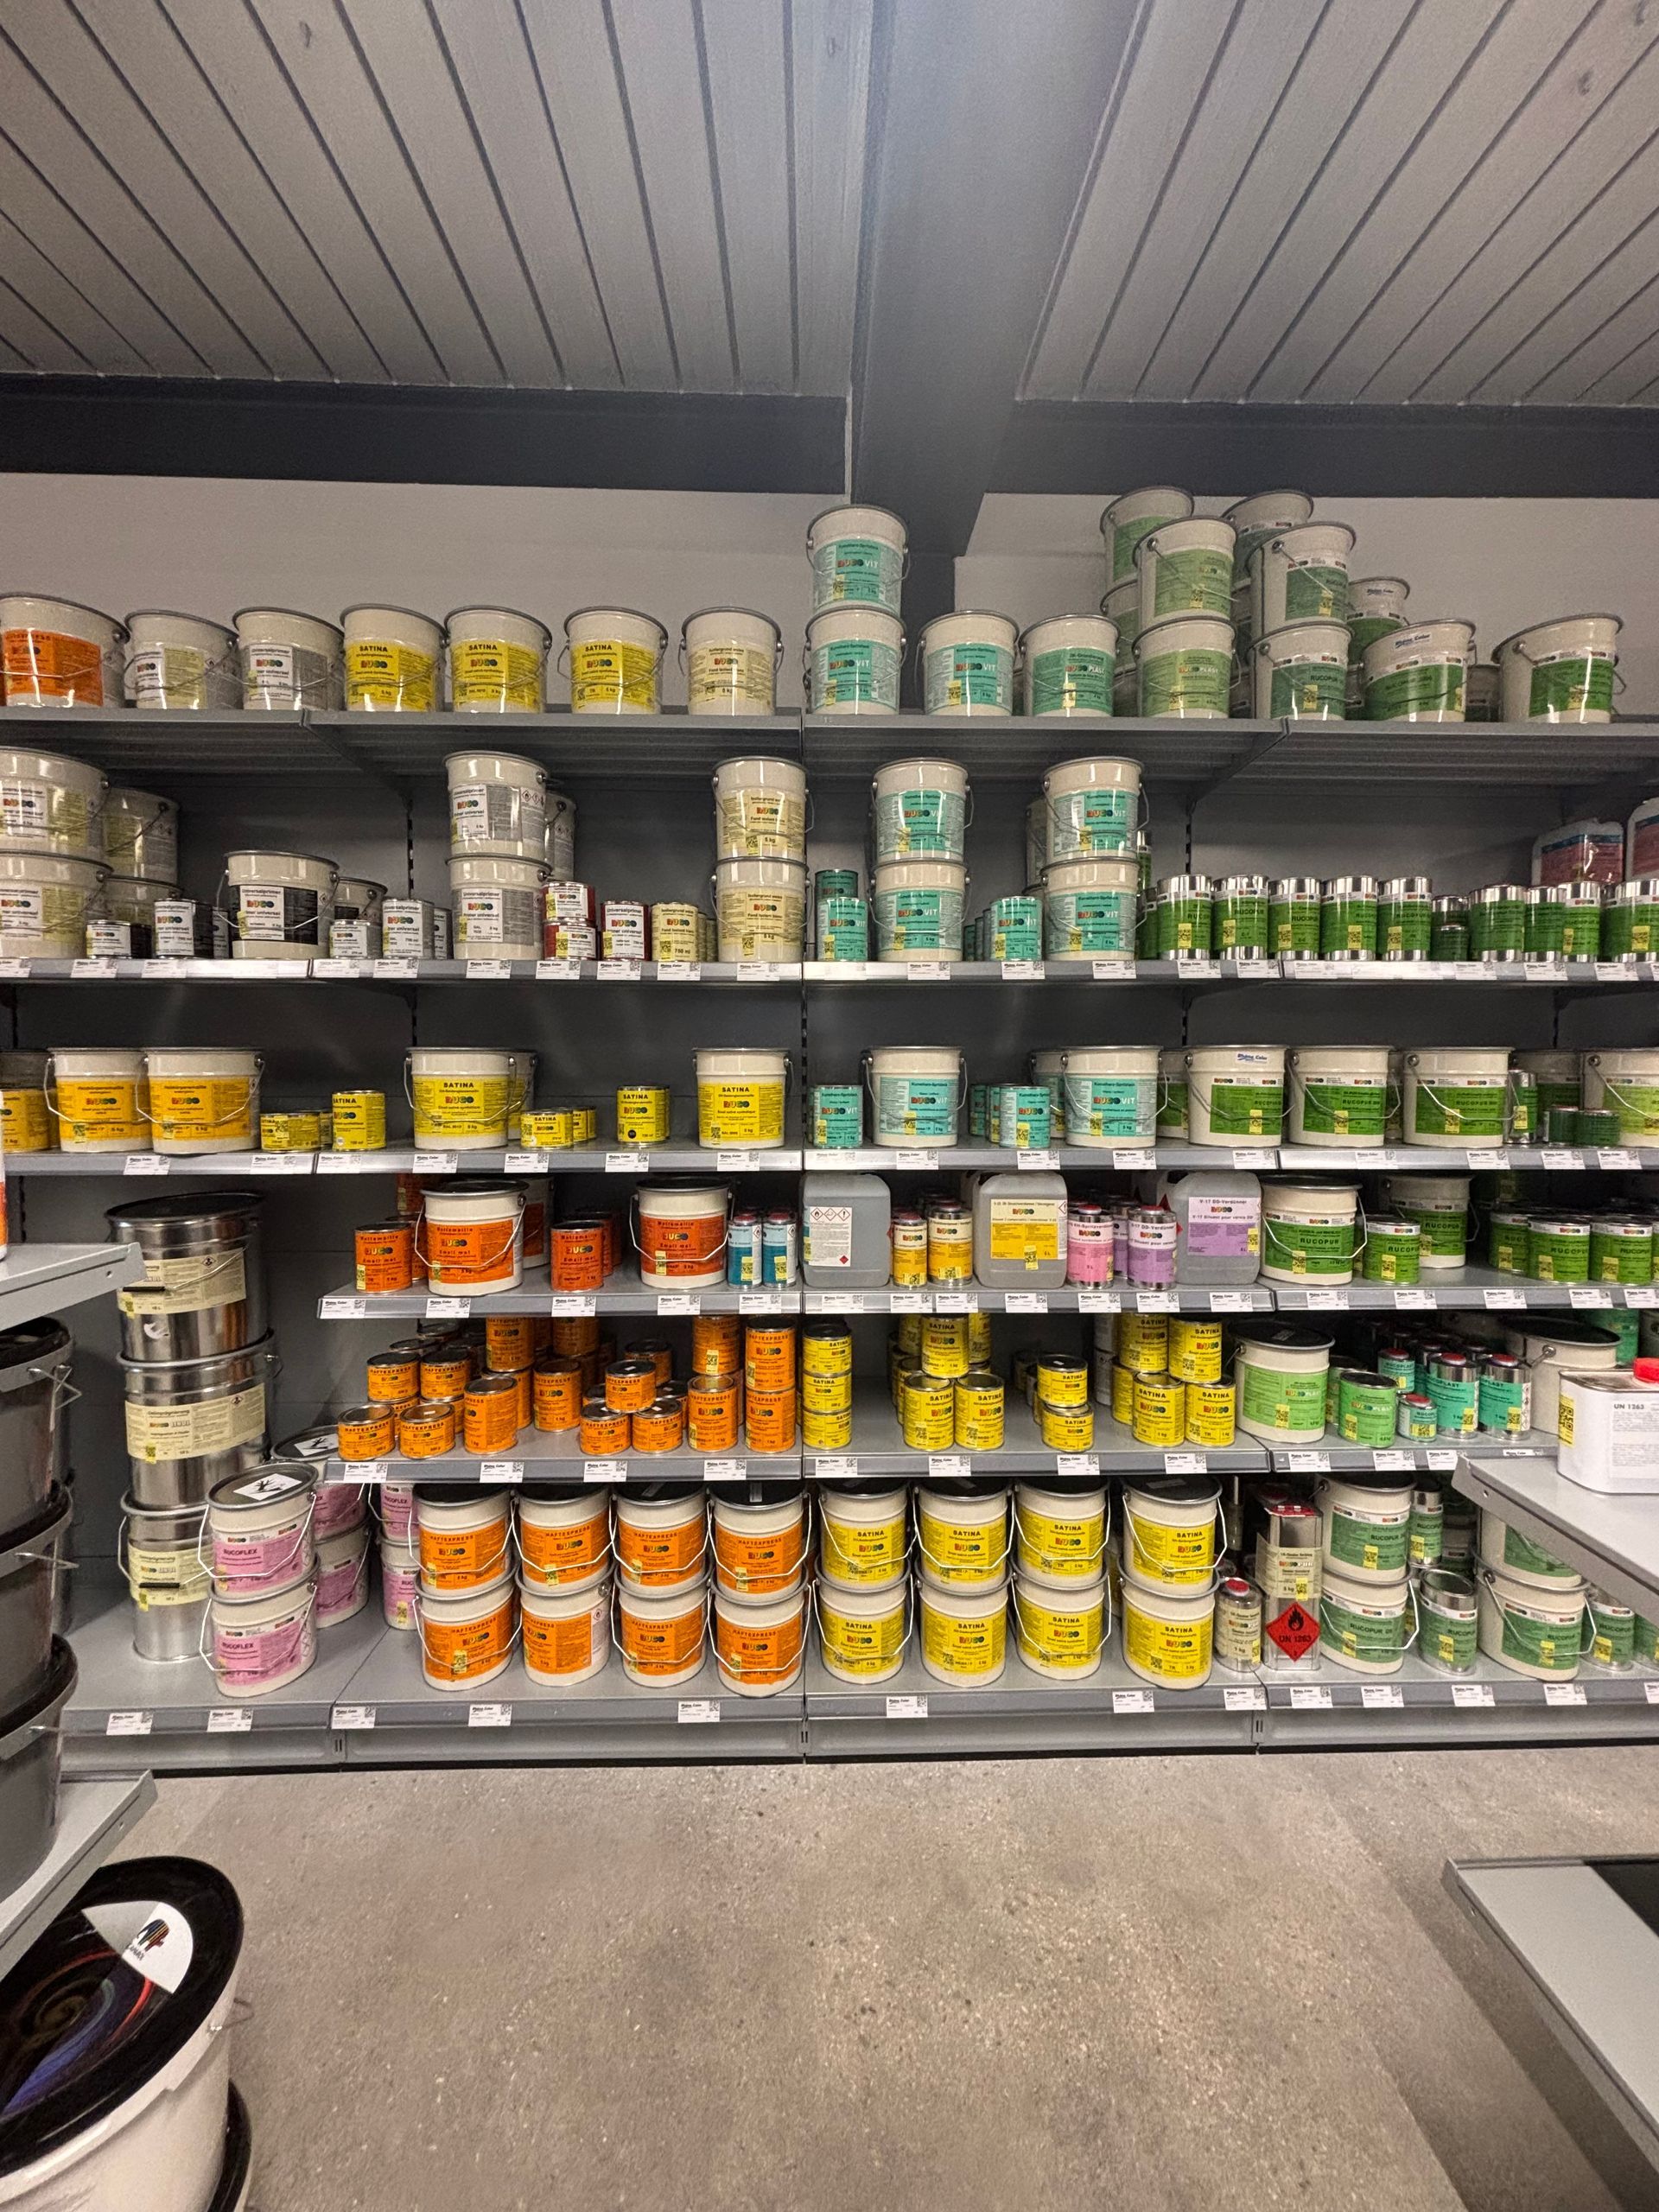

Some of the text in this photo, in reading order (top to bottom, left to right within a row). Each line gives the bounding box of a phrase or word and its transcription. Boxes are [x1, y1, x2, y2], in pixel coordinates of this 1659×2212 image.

[457, 800, 478, 809] RUCO
[753, 903, 778, 912] RUCO
[723, 1100, 750, 1109] RUCO
[623, 1106, 648, 1115] RUCO
[663, 1232, 689, 1241] RUCO
[365, 1247, 393, 1255] RUCO
[931, 1336, 955, 1344] RUCO
[1139, 1389, 1166, 1398] SATINA
[750, 1408, 773, 1416] RUCO
[1140, 1402, 1166, 1414] RUCO
[1204, 1405, 1230, 1414] RUCO
[556, 1540, 583, 1550] RUCO
[1055, 1537, 1081, 1546] RUCO
[438, 1547, 466, 1555] RUCO
[643, 1544, 670, 1553] RUCO
[859, 1543, 884, 1553] RUCO
[955, 1543, 981, 1552] RUCO
[1178, 1545, 1202, 1554] RUCO
[747, 1551, 774, 1560] RUCO
[1350, 1623, 1382, 1633] RUCOPUR
[462, 1631, 490, 1643] RUCO
[639, 1634, 665, 1643] RUCO
[1053, 1630, 1080, 1639] RUCO
[847, 1636, 872, 1644] RUCO
[959, 1637, 985, 1645] RUCO
[1166, 1639, 1192, 1649] RUCO
[741, 1643, 768, 1651] RUCO
